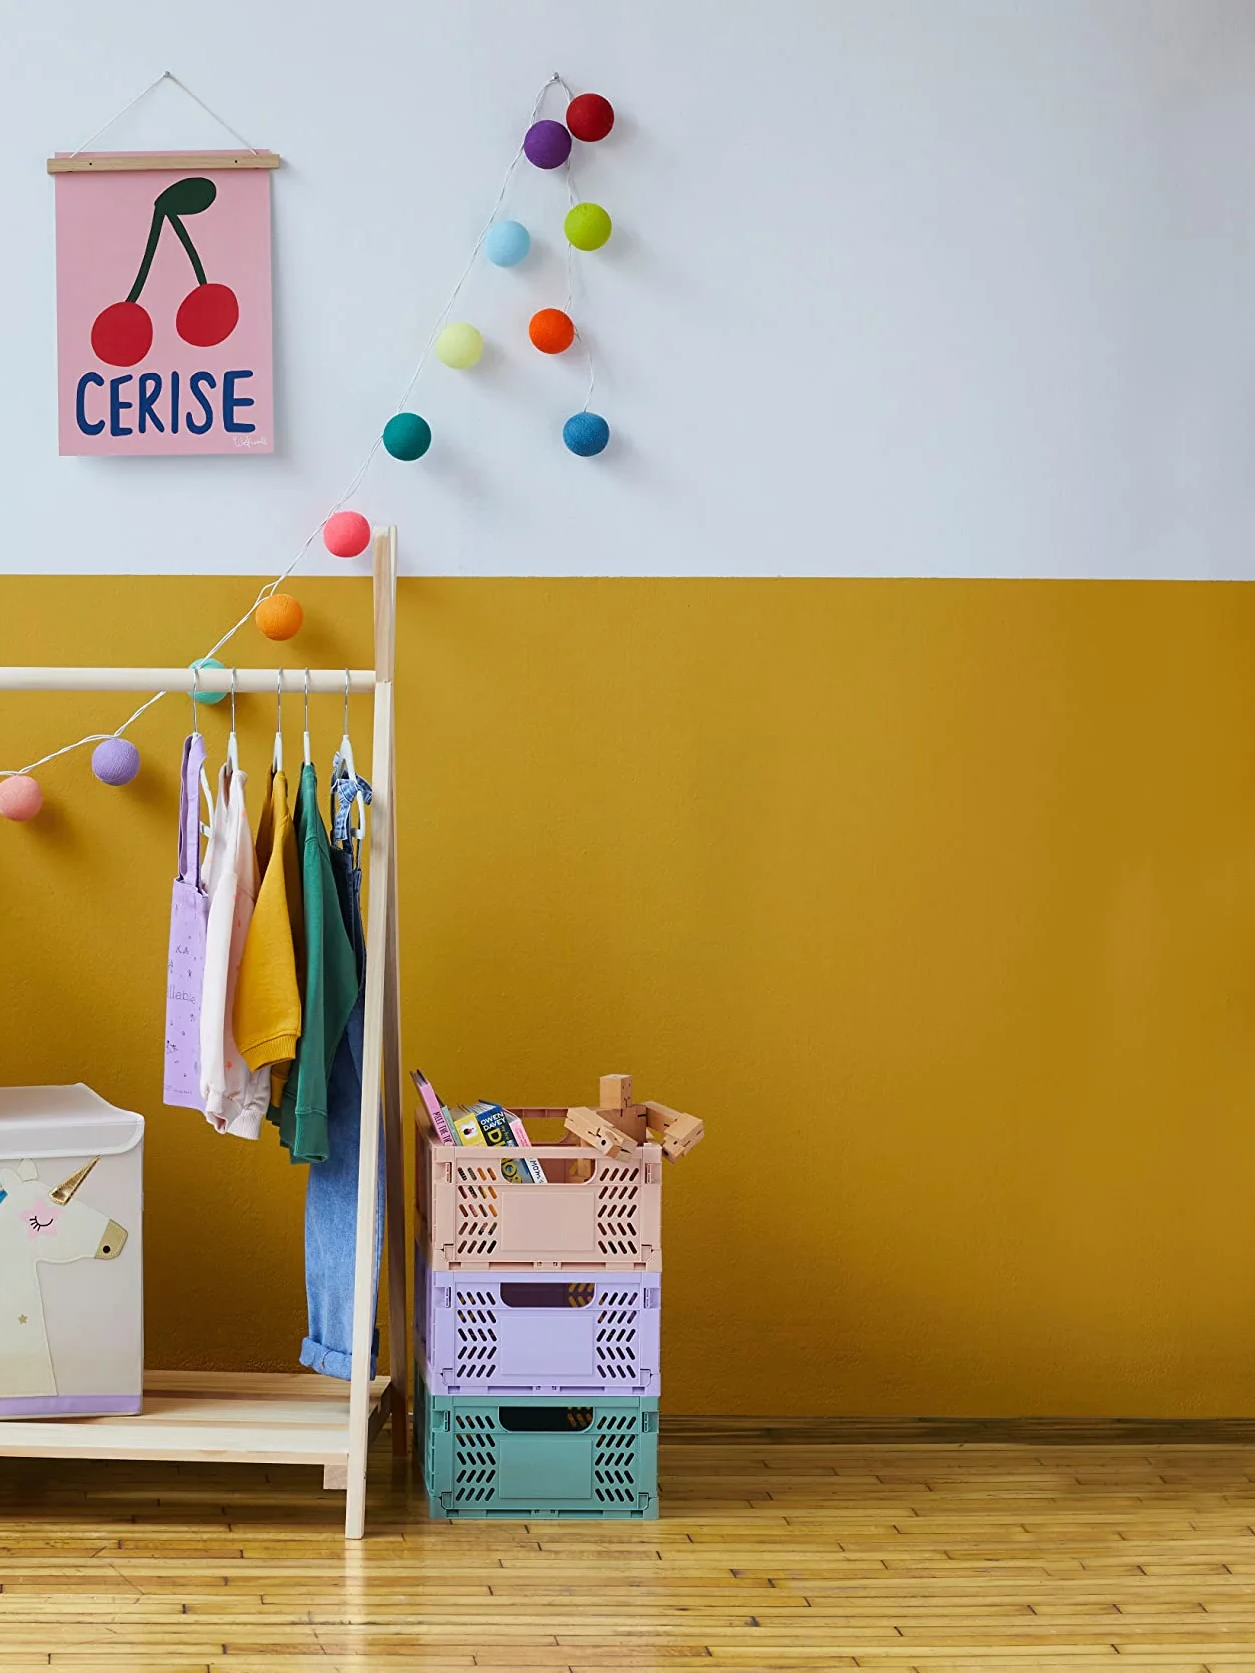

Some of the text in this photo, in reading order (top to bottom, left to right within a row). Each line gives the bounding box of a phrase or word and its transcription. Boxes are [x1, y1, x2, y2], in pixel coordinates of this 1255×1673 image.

[76, 370, 256, 437] CERISE
[480, 1111, 505, 1126] OWEN
[482, 1117, 506, 1132] DAVEY
